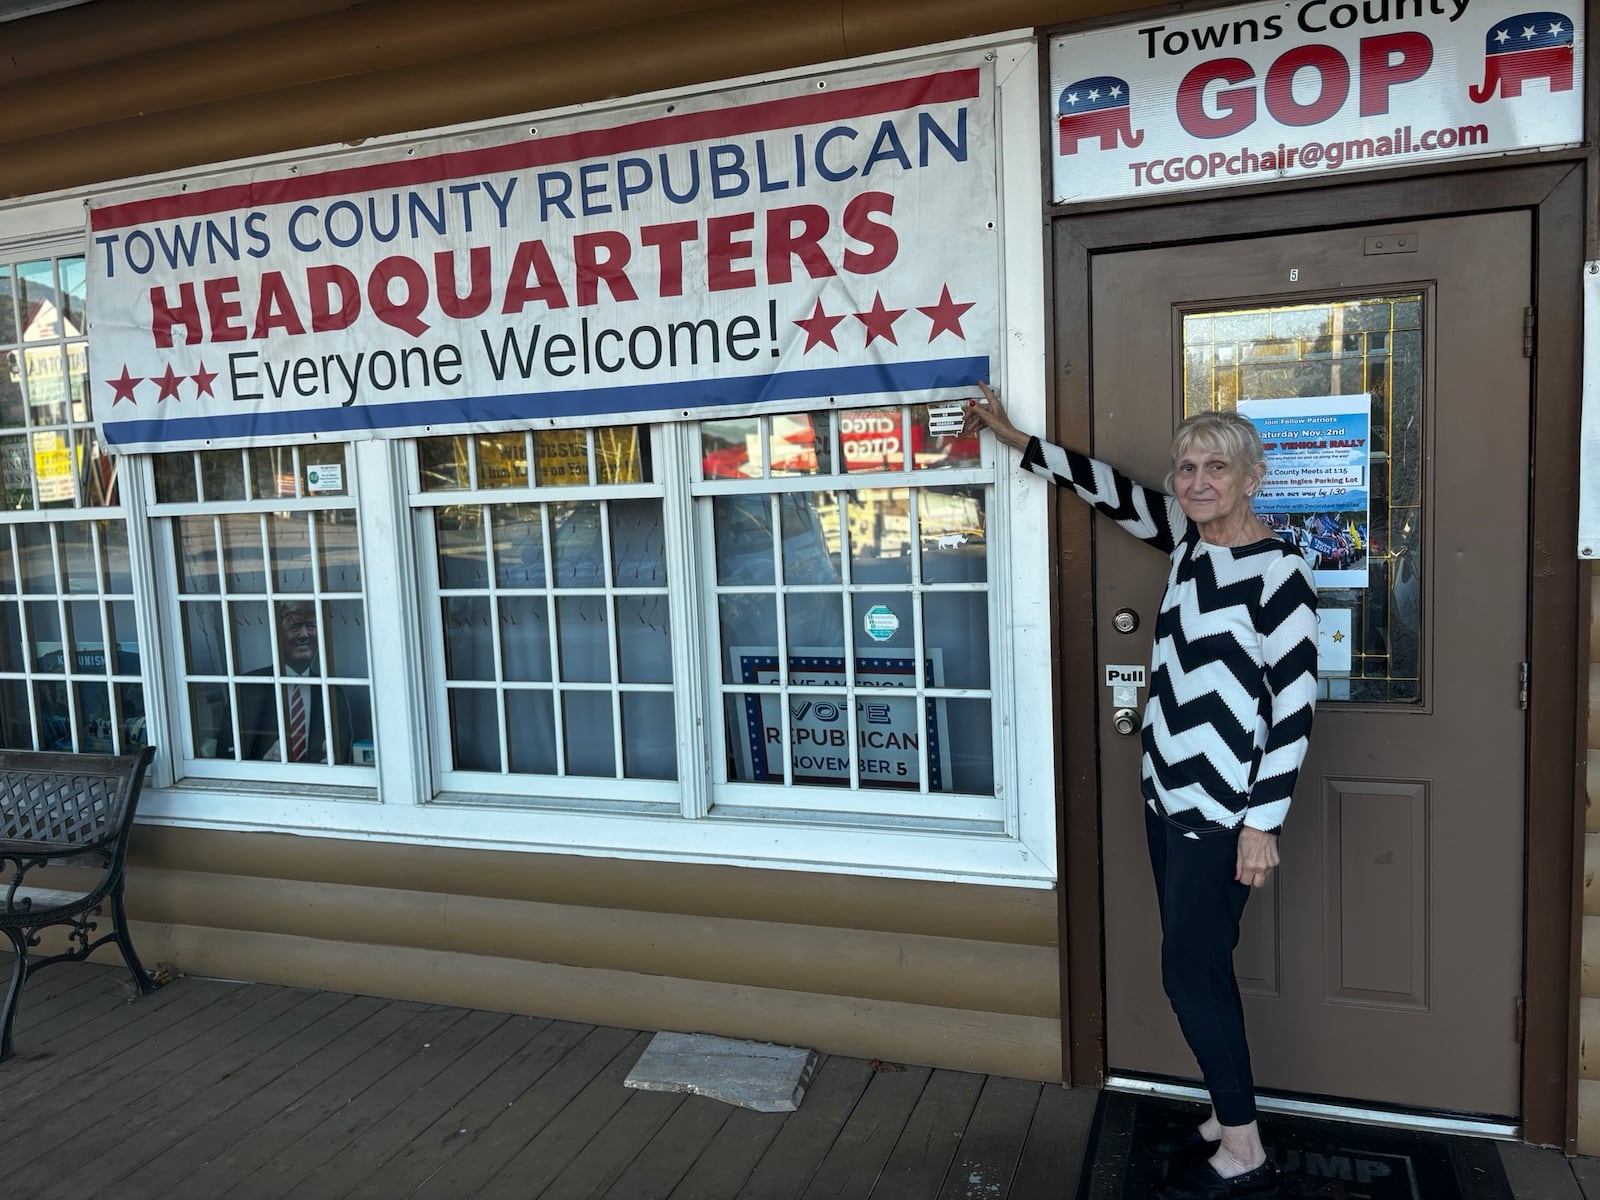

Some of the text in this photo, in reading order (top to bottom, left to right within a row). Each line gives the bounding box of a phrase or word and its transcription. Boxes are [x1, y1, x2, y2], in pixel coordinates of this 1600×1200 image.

[1138, 0, 1472, 59] Towns County
[1175, 31, 1434, 140] GOP
[1129, 123, 1489, 187] TCGOPchair@gmail.com
[96, 107, 968, 278] TOWNS COUNTY REPUBLICAN
[150, 191, 899, 349] HEADQUARTERS
[1290, 269, 1298, 281] 5
[228, 299, 780, 407] Everyone Welcome!
[1302, 429, 1322, 437] Nov.
[1326, 428, 1345, 436] 2nd
[1329, 439, 1365, 448] RALLY
[1319, 489, 1327, 499] by
[1108, 670, 1143, 682] Pull
[766, 727, 919, 751] RPUBICAN
[897, 762, 908, 776] 5
[1264, 1146, 1392, 1184] UMP
